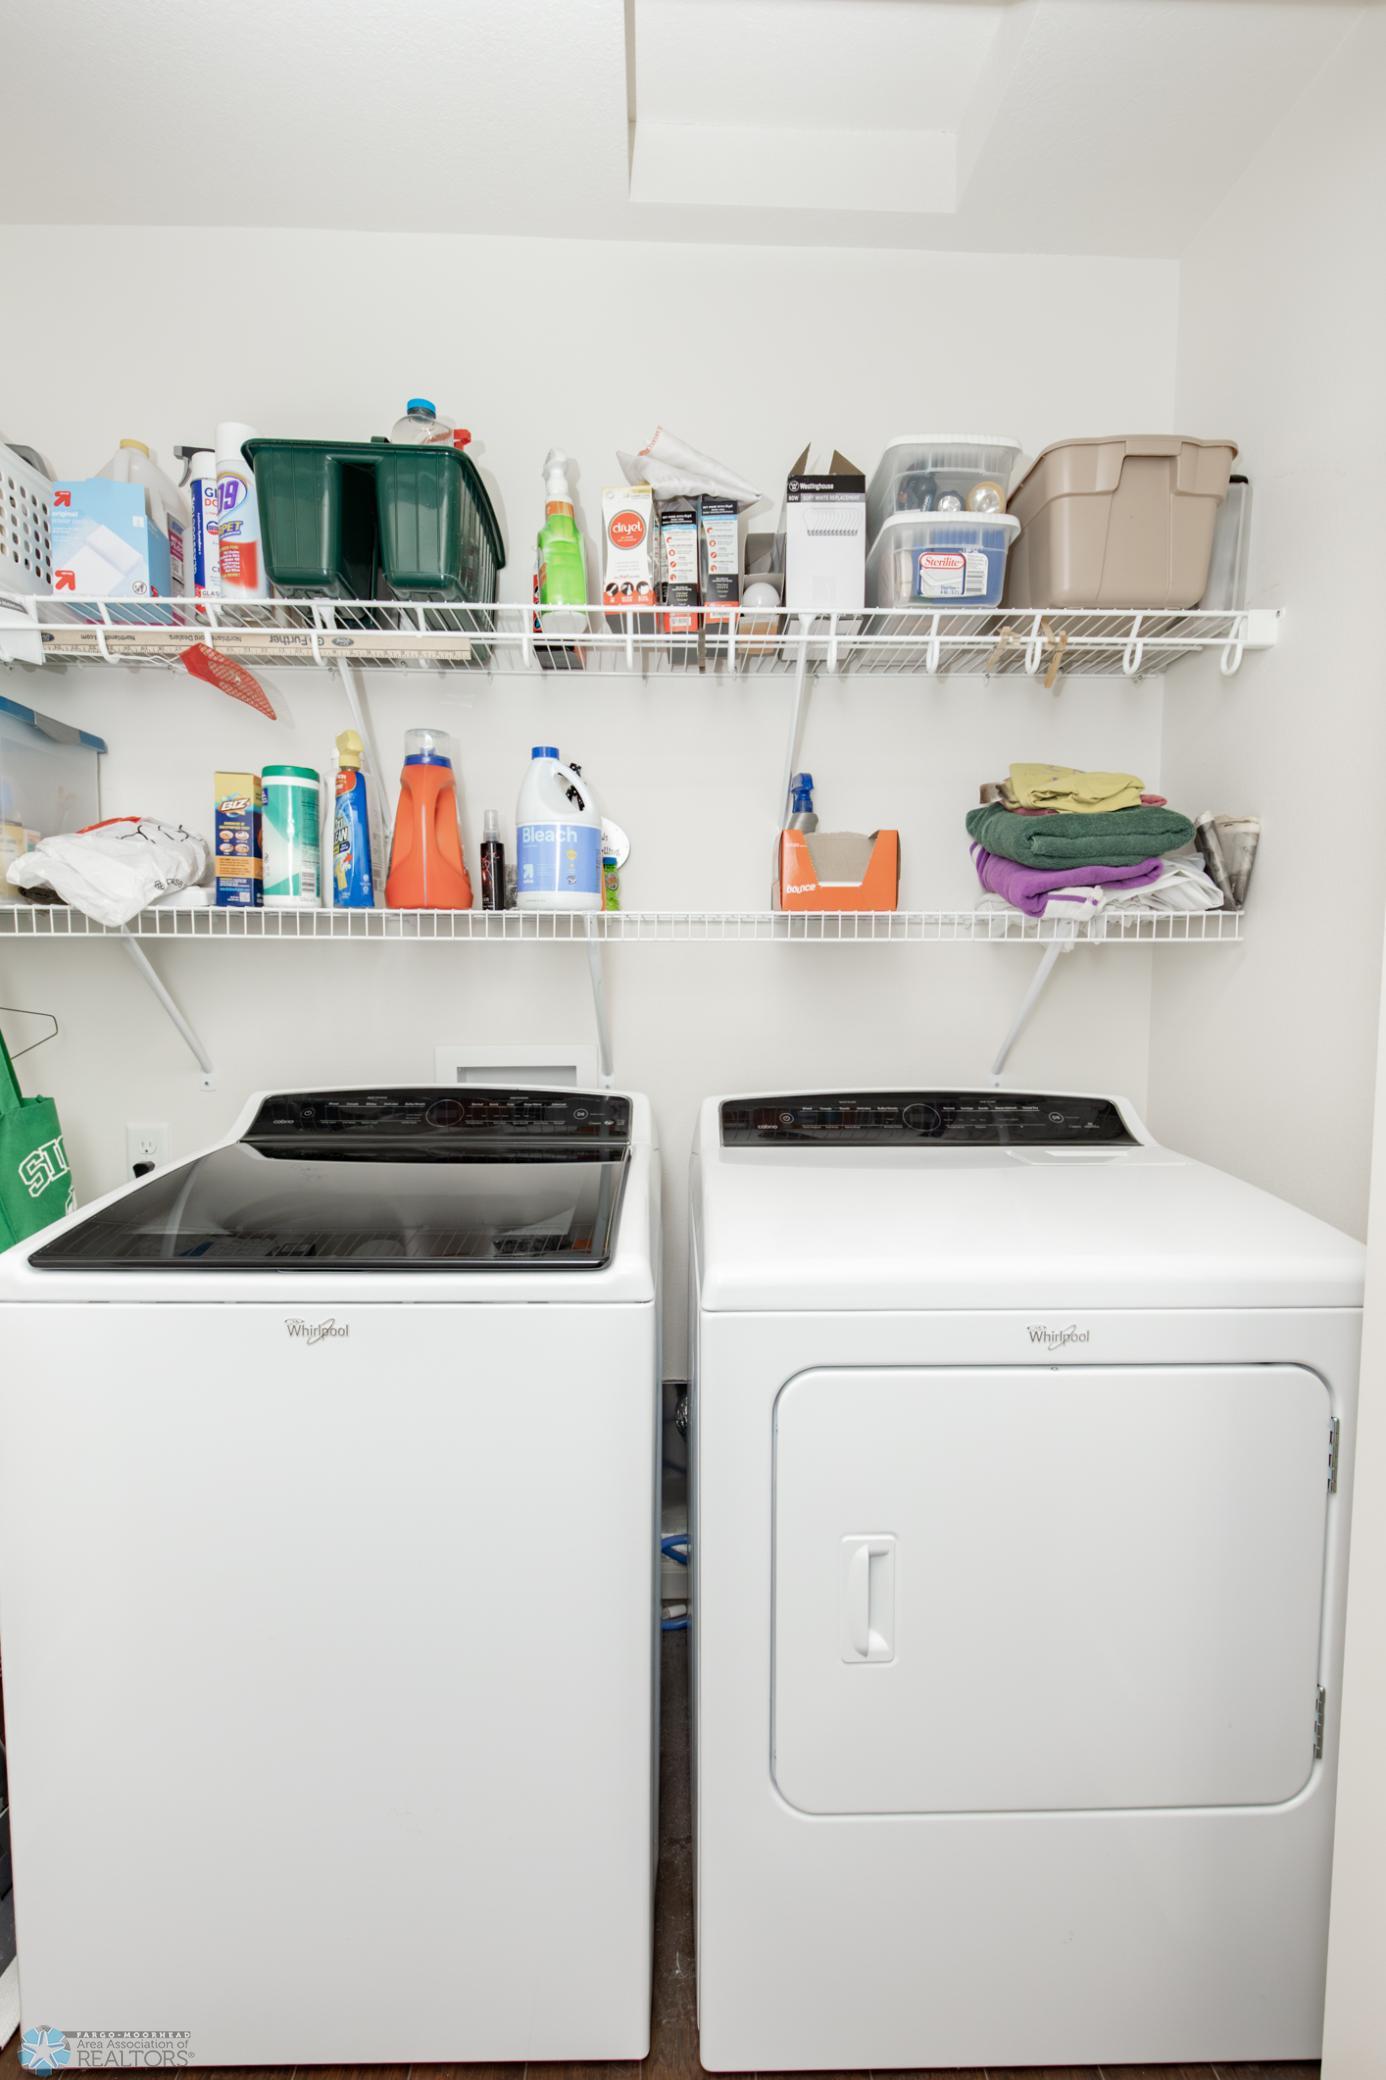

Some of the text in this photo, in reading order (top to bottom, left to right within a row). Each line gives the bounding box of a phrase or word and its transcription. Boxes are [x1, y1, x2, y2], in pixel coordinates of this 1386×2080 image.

[800, 482, 834, 491] Westinghouse
[612, 521, 643, 536] dryel
[924, 556, 960, 567] Sterilite
[269, 635, 308, 646] Further
[221, 798, 249, 811] BIZ
[522, 826, 578, 843] Bleach
[786, 884, 817, 894] bounce
[286, 1322, 349, 1343] Whirlpool
[1028, 1328, 1090, 1346] Whirlpool
